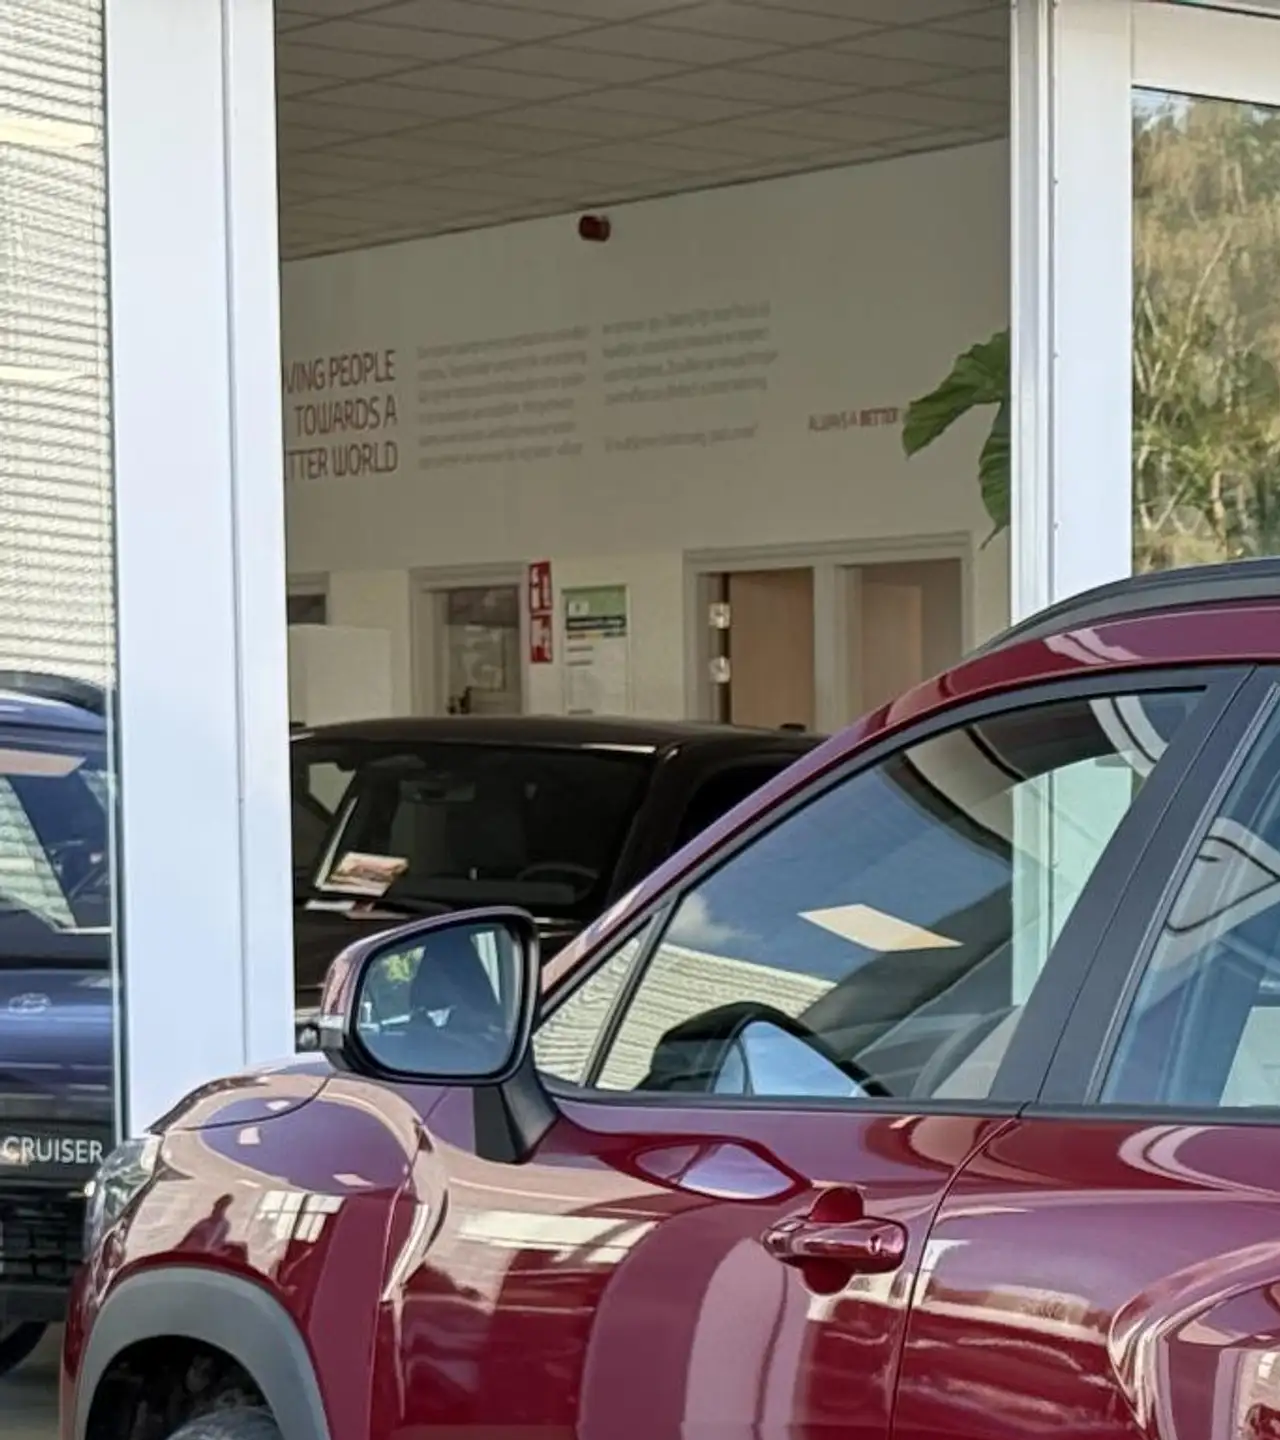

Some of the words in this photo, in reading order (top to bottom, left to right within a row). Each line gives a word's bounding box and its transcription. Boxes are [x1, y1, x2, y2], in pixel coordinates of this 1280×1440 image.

[329, 349, 398, 390] PEOPLE
[292, 396, 381, 438] TOWARDS
[382, 393, 400, 428] A
[331, 439, 400, 477] WORLD
[2, 1135, 104, 1165] CRUISER
